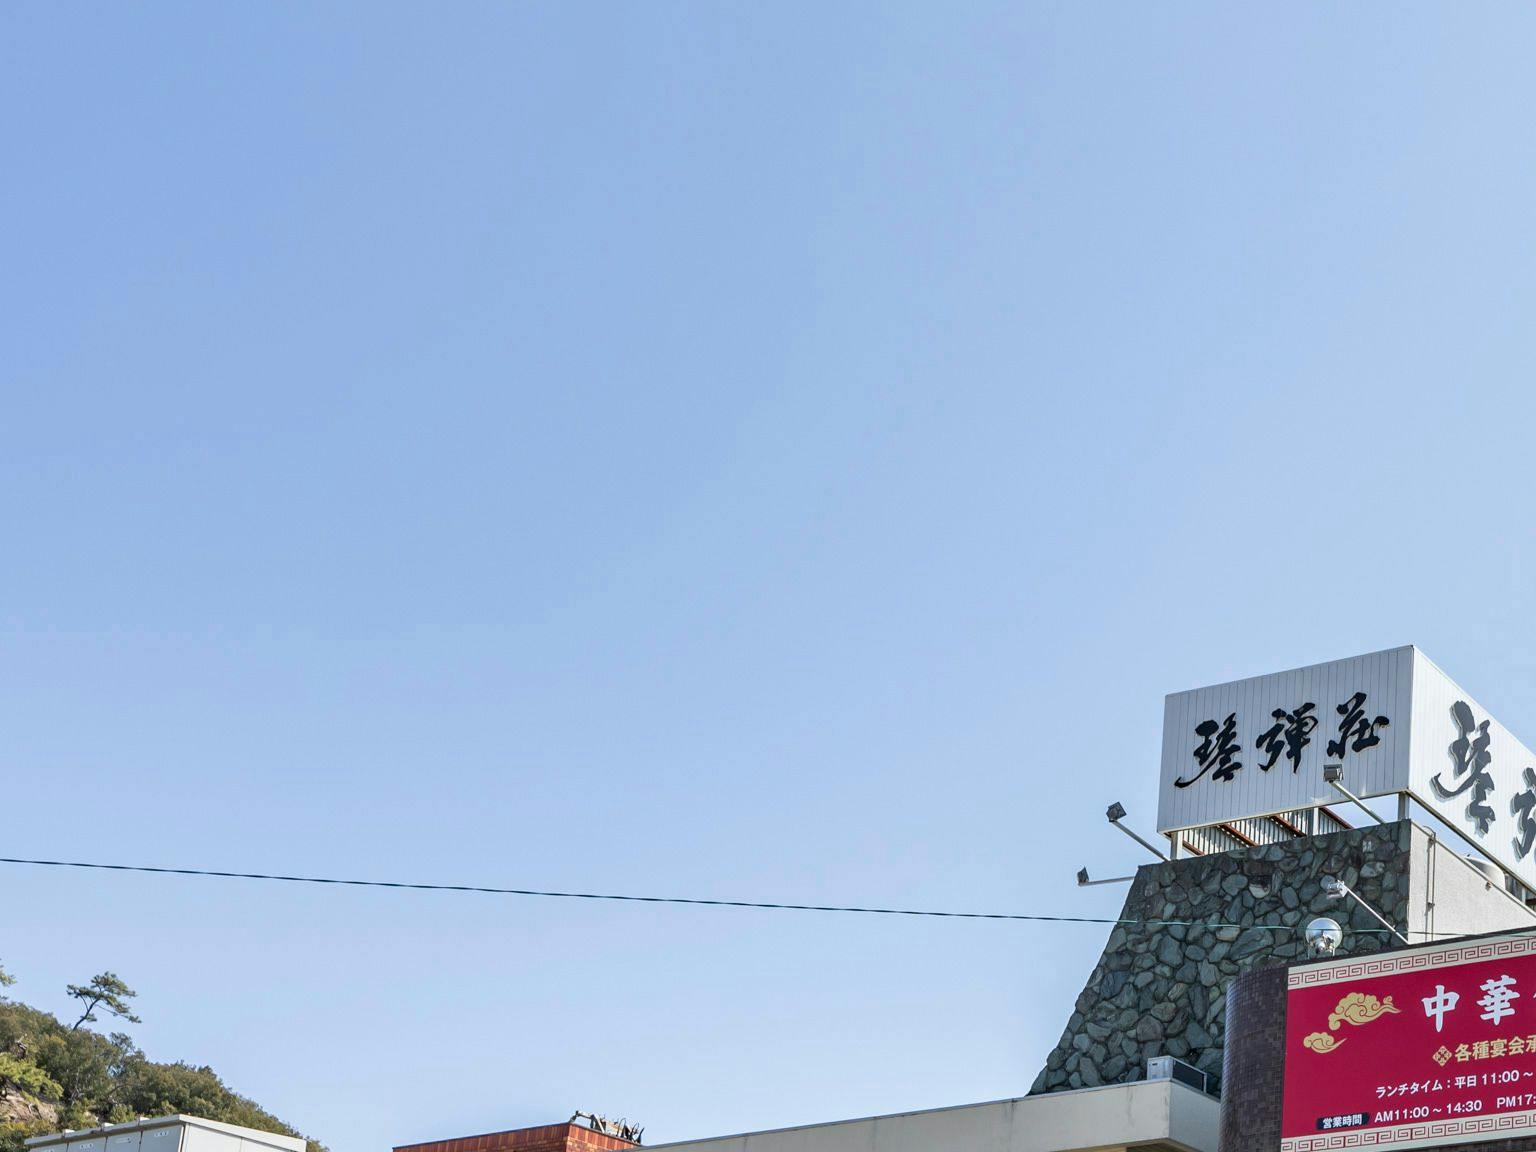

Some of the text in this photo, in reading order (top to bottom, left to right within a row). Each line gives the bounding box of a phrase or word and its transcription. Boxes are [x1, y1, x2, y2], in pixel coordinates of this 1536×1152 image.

[1481, 1069, 1520, 1085] 11:00
[1322, 1113, 1363, 1129] 営業時間
[1374, 1106, 1430, 1123] AM11:00
[1446, 1099, 1483, 1115] 14:30
